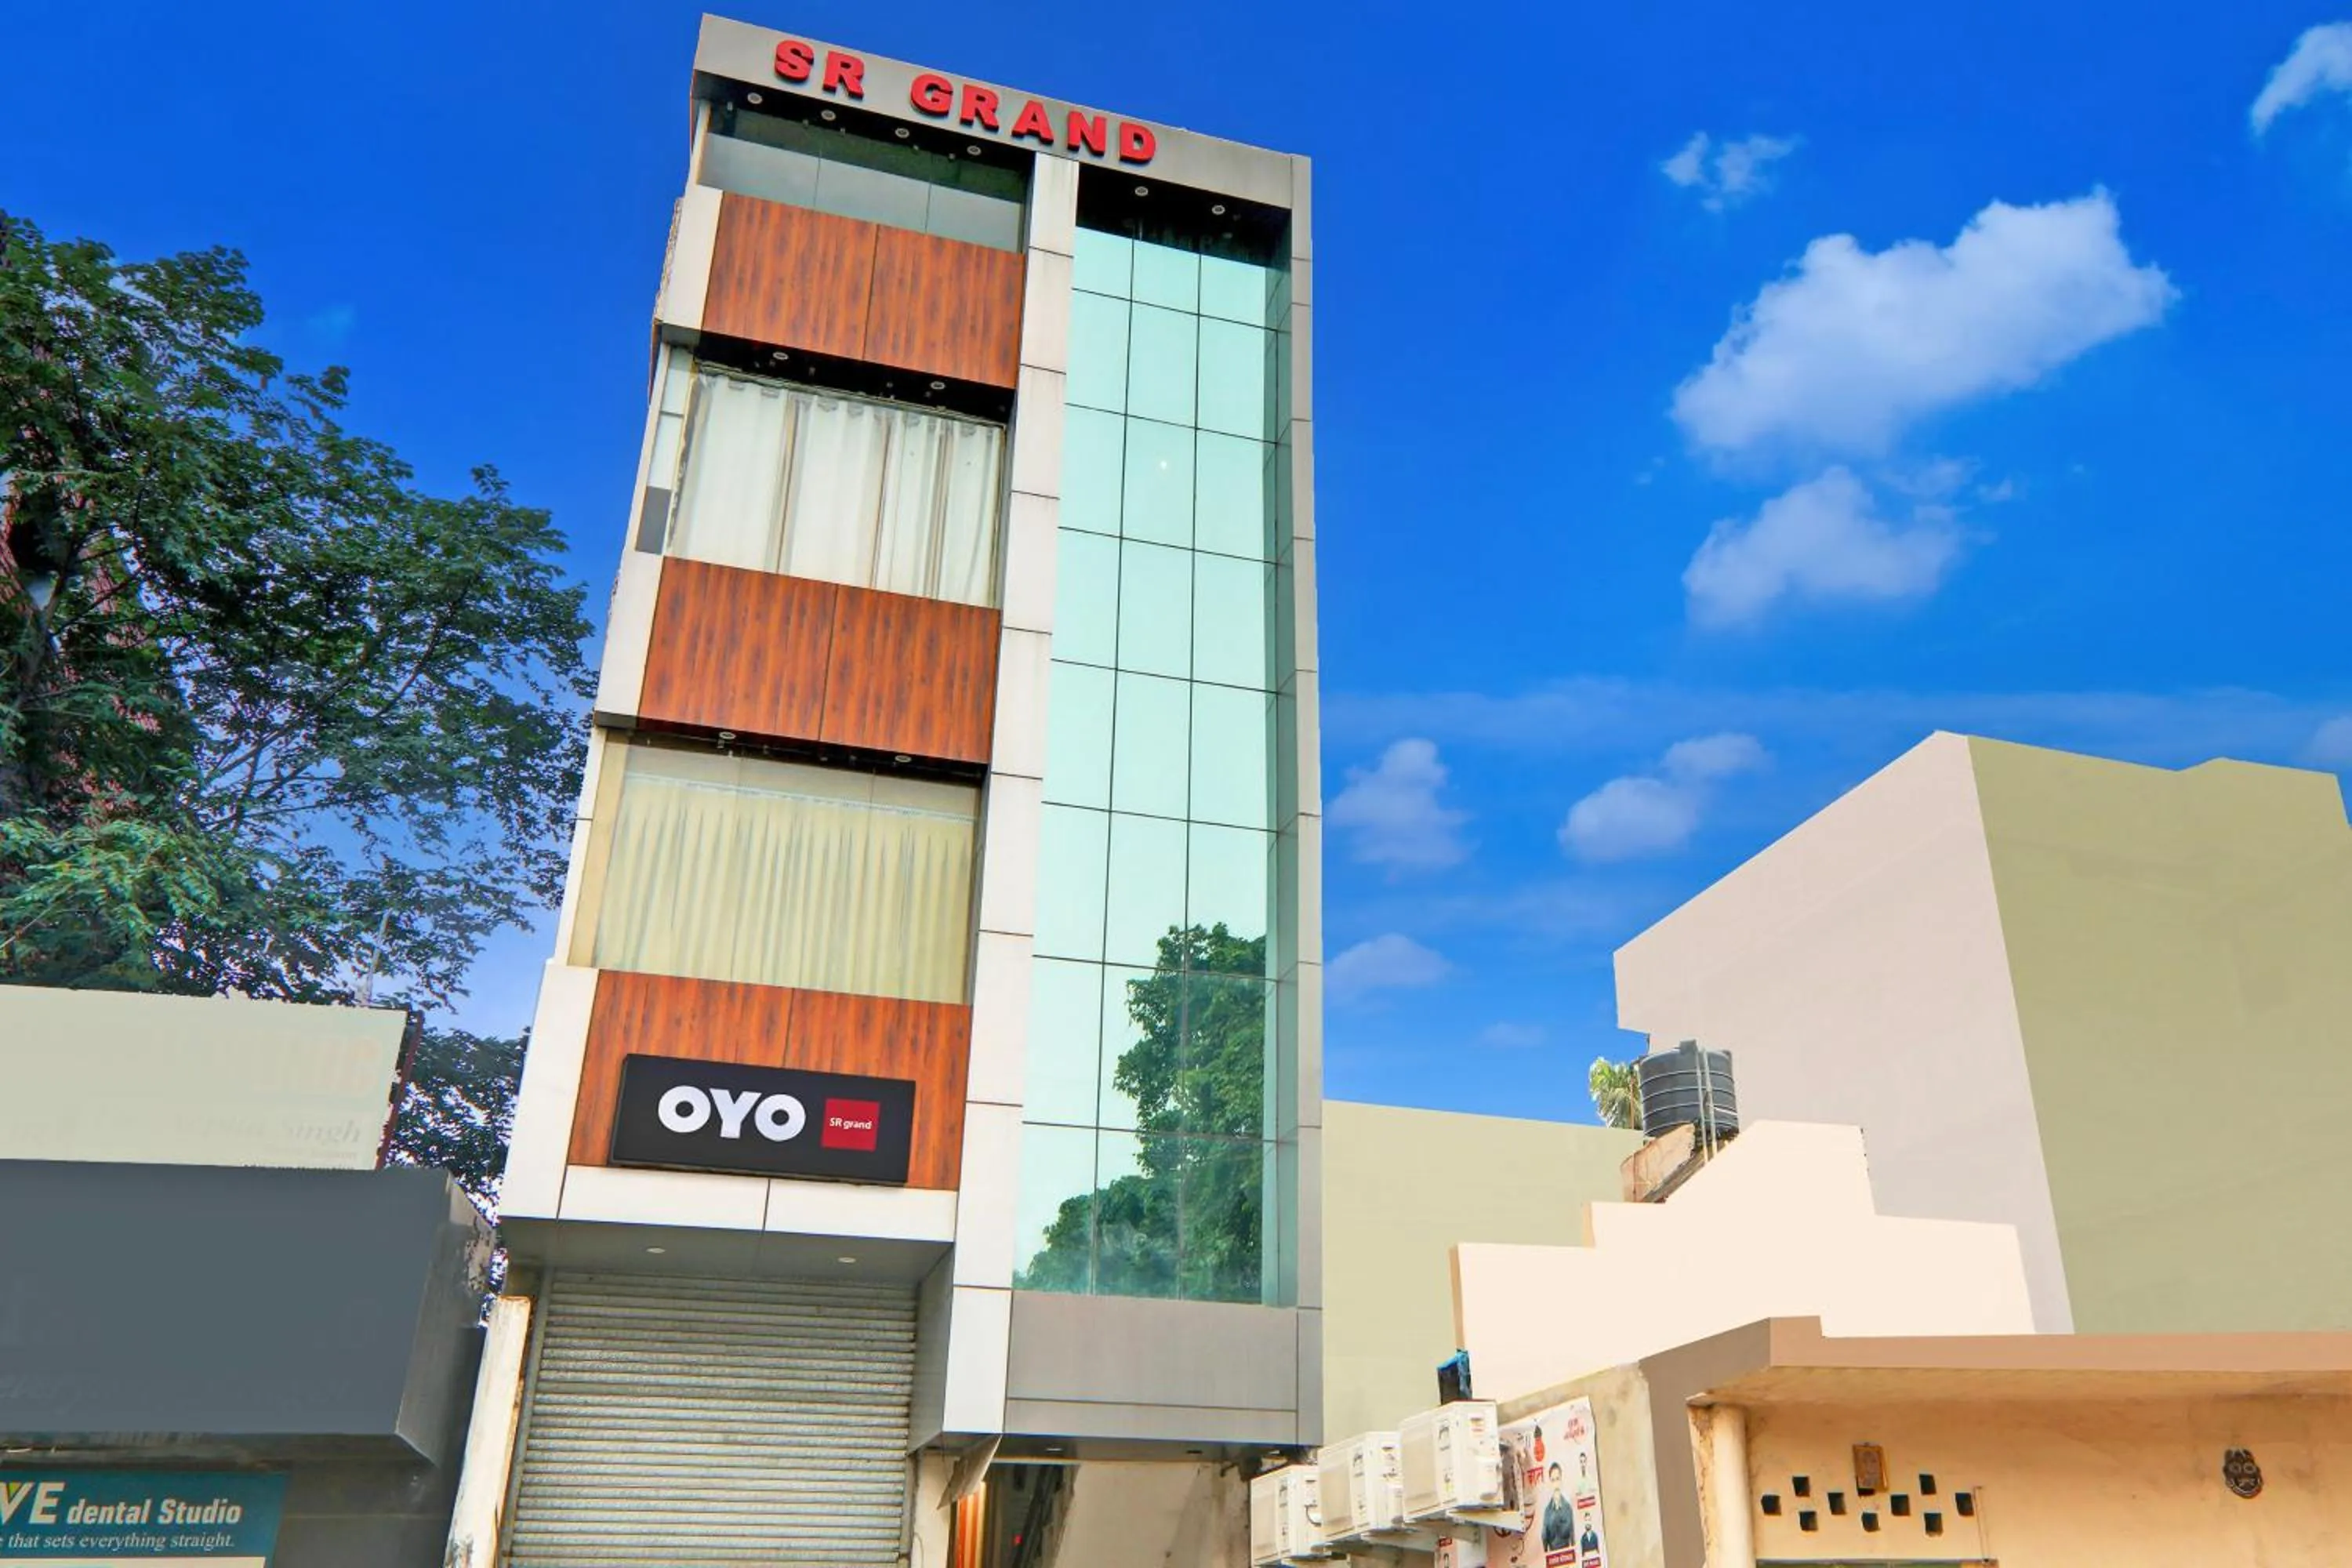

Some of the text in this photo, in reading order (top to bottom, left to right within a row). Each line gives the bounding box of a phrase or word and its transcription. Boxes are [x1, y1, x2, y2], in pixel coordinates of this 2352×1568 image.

[773, 39, 1157, 165] SR GRAND
[657, 1085, 806, 1142] OYO
[829, 1116, 873, 1130] SR grand
[67, 1497, 151, 1525] dental
[158, 1497, 242, 1525] Studio
[8, 1533, 39, 1548] that
[43, 1534, 76, 1548] sets
[79, 1532, 166, 1552] everything
[170, 1532, 234, 1552] straight.
